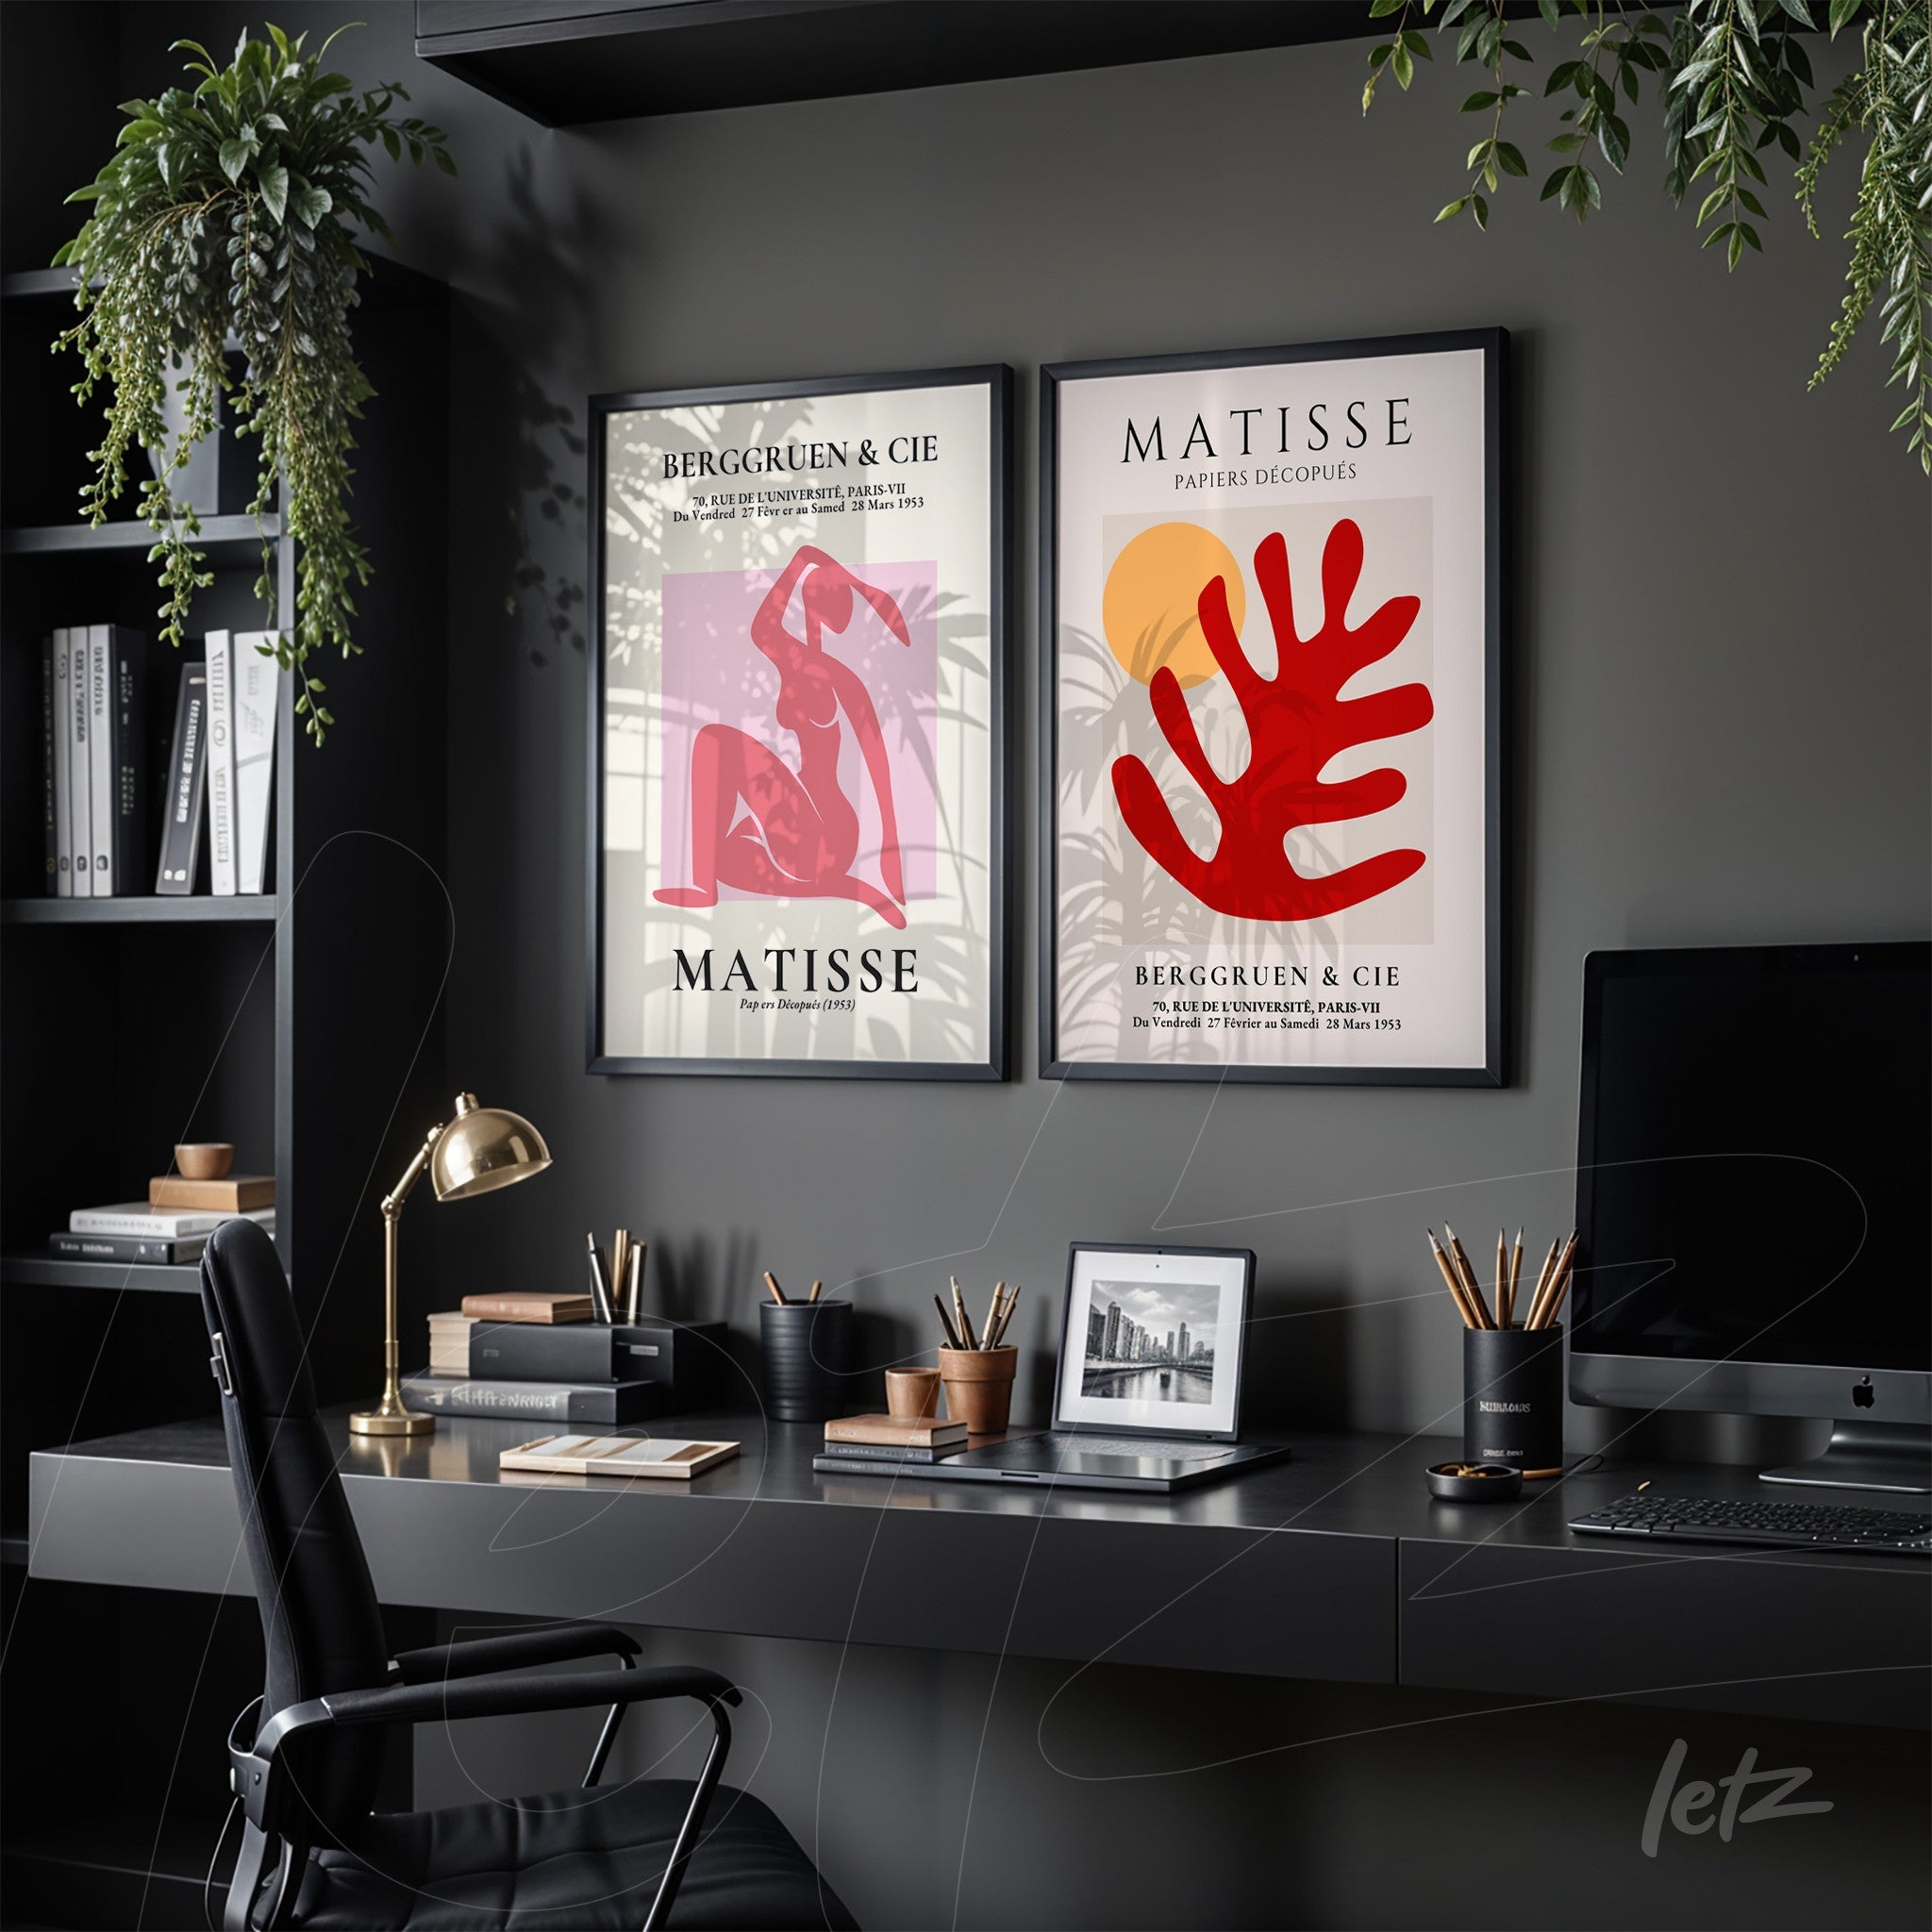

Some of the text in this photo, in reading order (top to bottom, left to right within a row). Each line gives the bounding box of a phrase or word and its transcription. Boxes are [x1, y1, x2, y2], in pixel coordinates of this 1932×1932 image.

[1120, 397, 1412, 464] MATISSE
[662, 435, 939, 479] BERGGRUEN & CIE
[1174, 459, 1357, 490] PAPIERS DÉCOPUÉS
[692, 495, 708, 508] 70,
[710, 493, 736, 507] RUE
[738, 491, 755, 505] DE
[847, 482, 906, 498] PARIS-VII
[673, 510, 690, 523] Du
[741, 507, 755, 519] 27
[795, 507, 808, 515] au
[851, 500, 865, 511] 28
[867, 498, 894, 510] Mars
[898, 496, 924, 508] 1953
[672, 947, 919, 993] MATISSE
[1135, 965, 1400, 987] BERGGRUEN & CIE
[823, 998, 856, 1013] (1953)
[1152, 1001, 1170, 1014] 70,
[1173, 1000, 1200, 1012] RUE
[1201, 1001, 1220, 1012] DE
[1317, 1001, 1380, 1014] PARIS-VII
[1132, 1016, 1150, 1028] Du
[1152, 1016, 1201, 1028] Vendredi
[1208, 1017, 1221, 1028] 27
[1264, 1021, 1277, 1029] au
[1279, 1017, 1320, 1029] Samedi
[1325, 1018, 1340, 1030] 28
[1342, 1018, 1371, 1030] Mars
[1374, 1018, 1402, 1031] 1953
